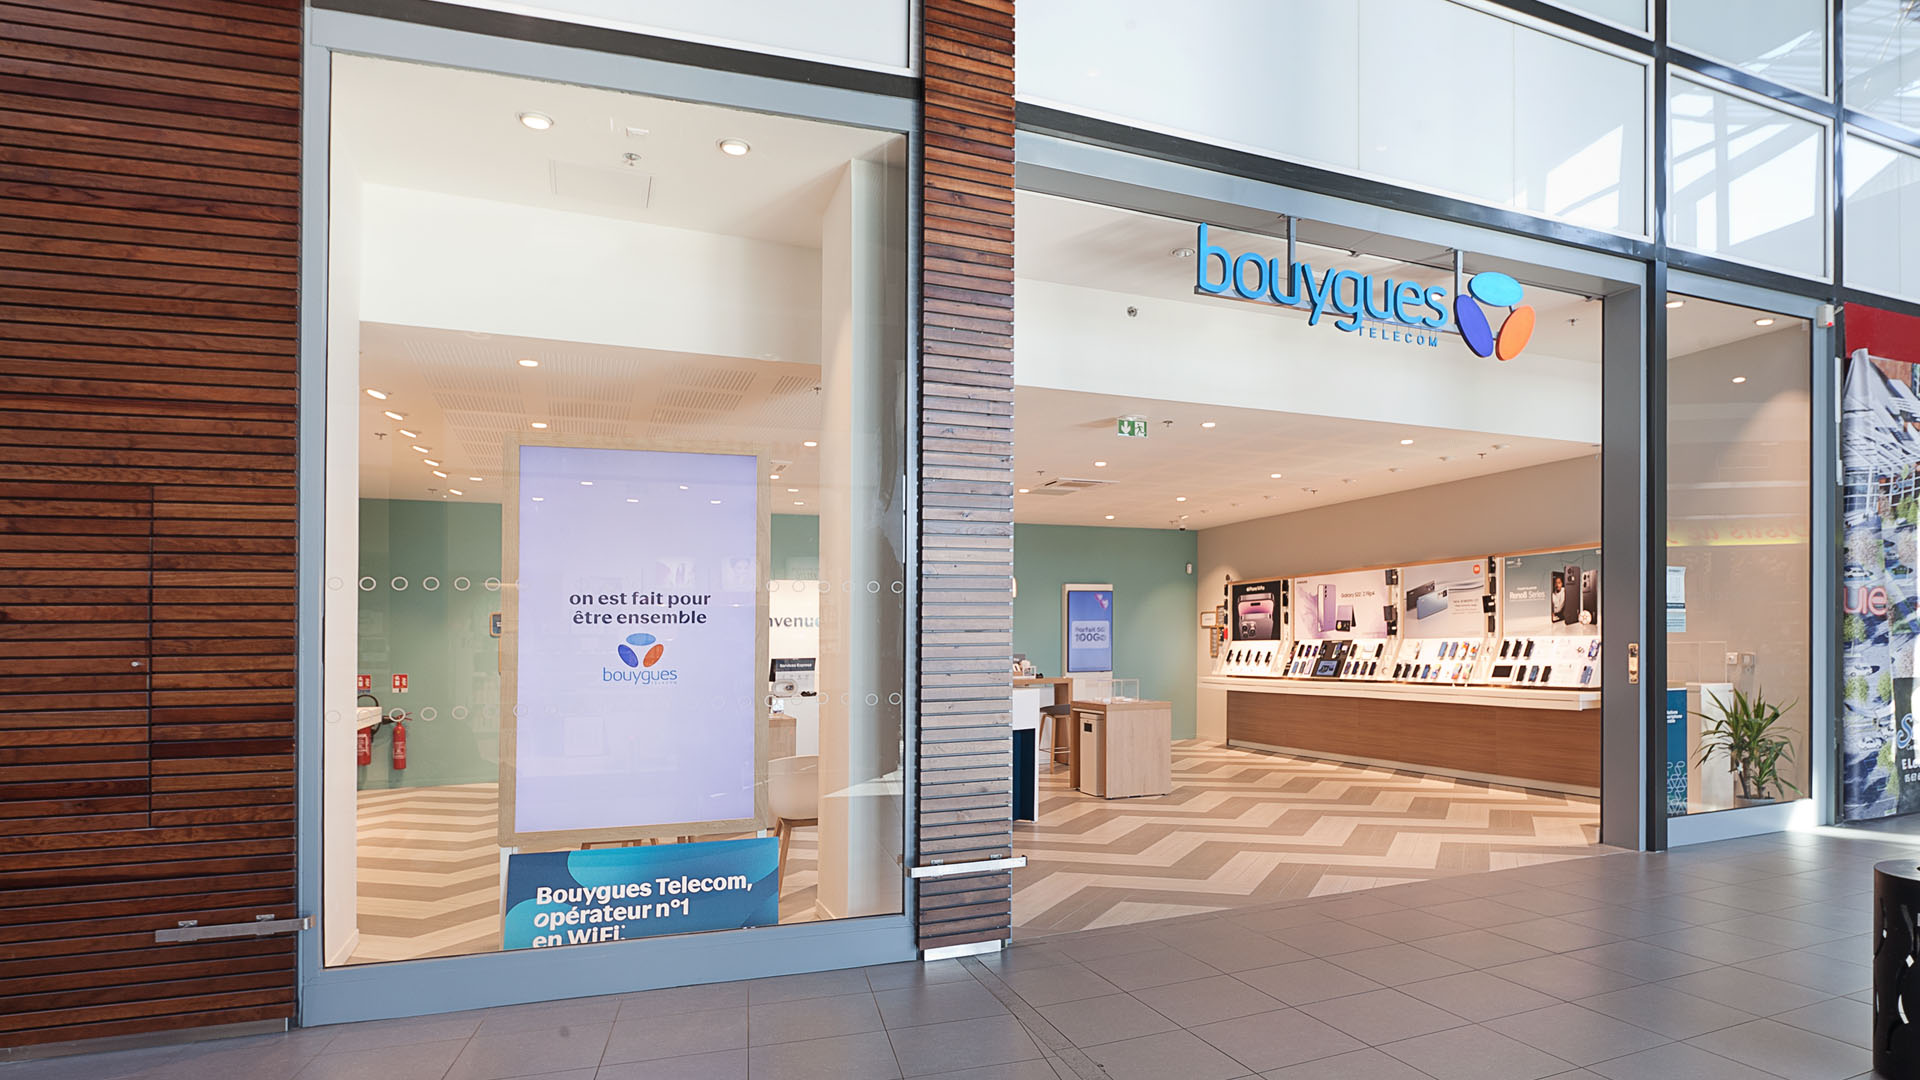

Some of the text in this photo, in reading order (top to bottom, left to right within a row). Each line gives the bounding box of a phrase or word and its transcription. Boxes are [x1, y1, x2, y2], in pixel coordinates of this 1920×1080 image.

[1197, 222, 1448, 332] bouygues
[1358, 326, 1439, 348] TELECOM
[569, 591, 712, 609] on est fait pour
[572, 610, 707, 625] être ensemble
[602, 667, 678, 685] bouygues
[536, 874, 753, 906] Bouygues Telecom,
[533, 897, 690, 930] opérateur n°1
[532, 933, 563, 948] en
